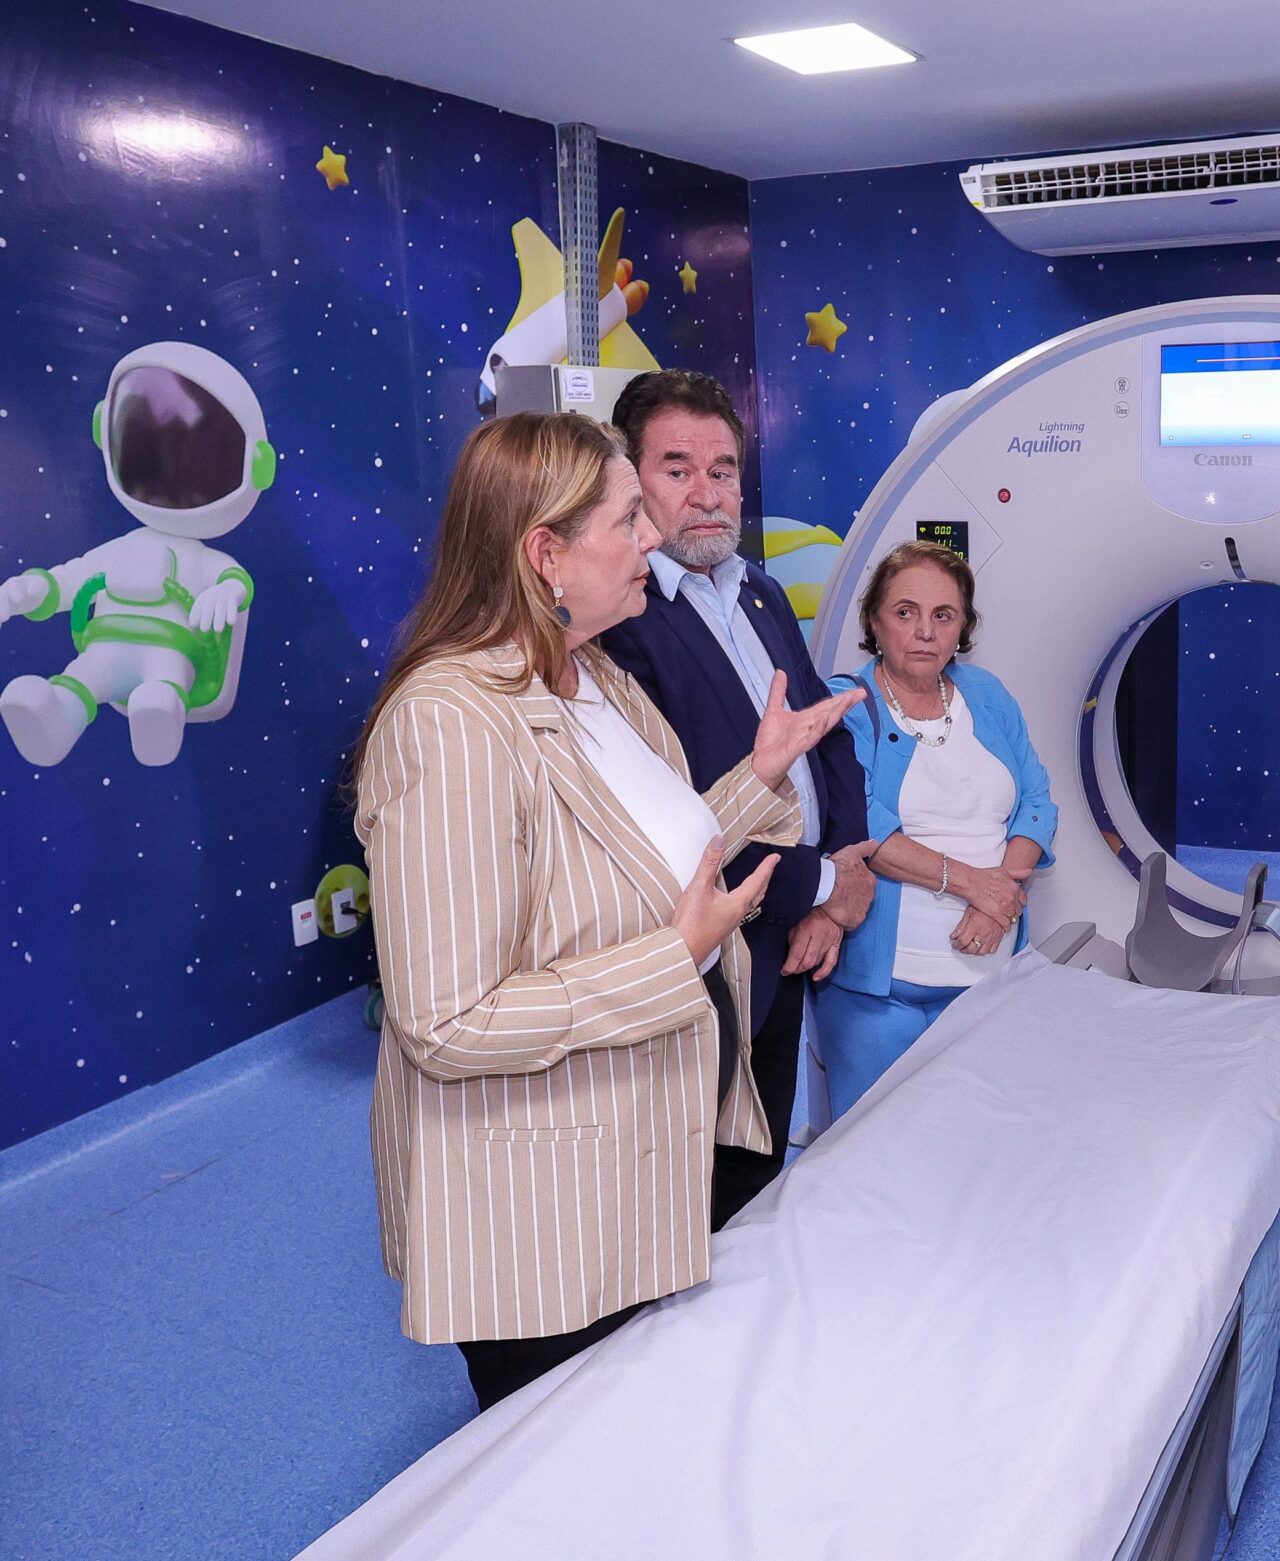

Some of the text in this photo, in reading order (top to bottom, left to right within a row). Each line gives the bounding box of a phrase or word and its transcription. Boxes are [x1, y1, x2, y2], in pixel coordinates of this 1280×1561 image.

[1039, 421, 1085, 434] Lightning
[1006, 435, 1082, 457] Aquilion
[1193, 452, 1253, 467] Canon
